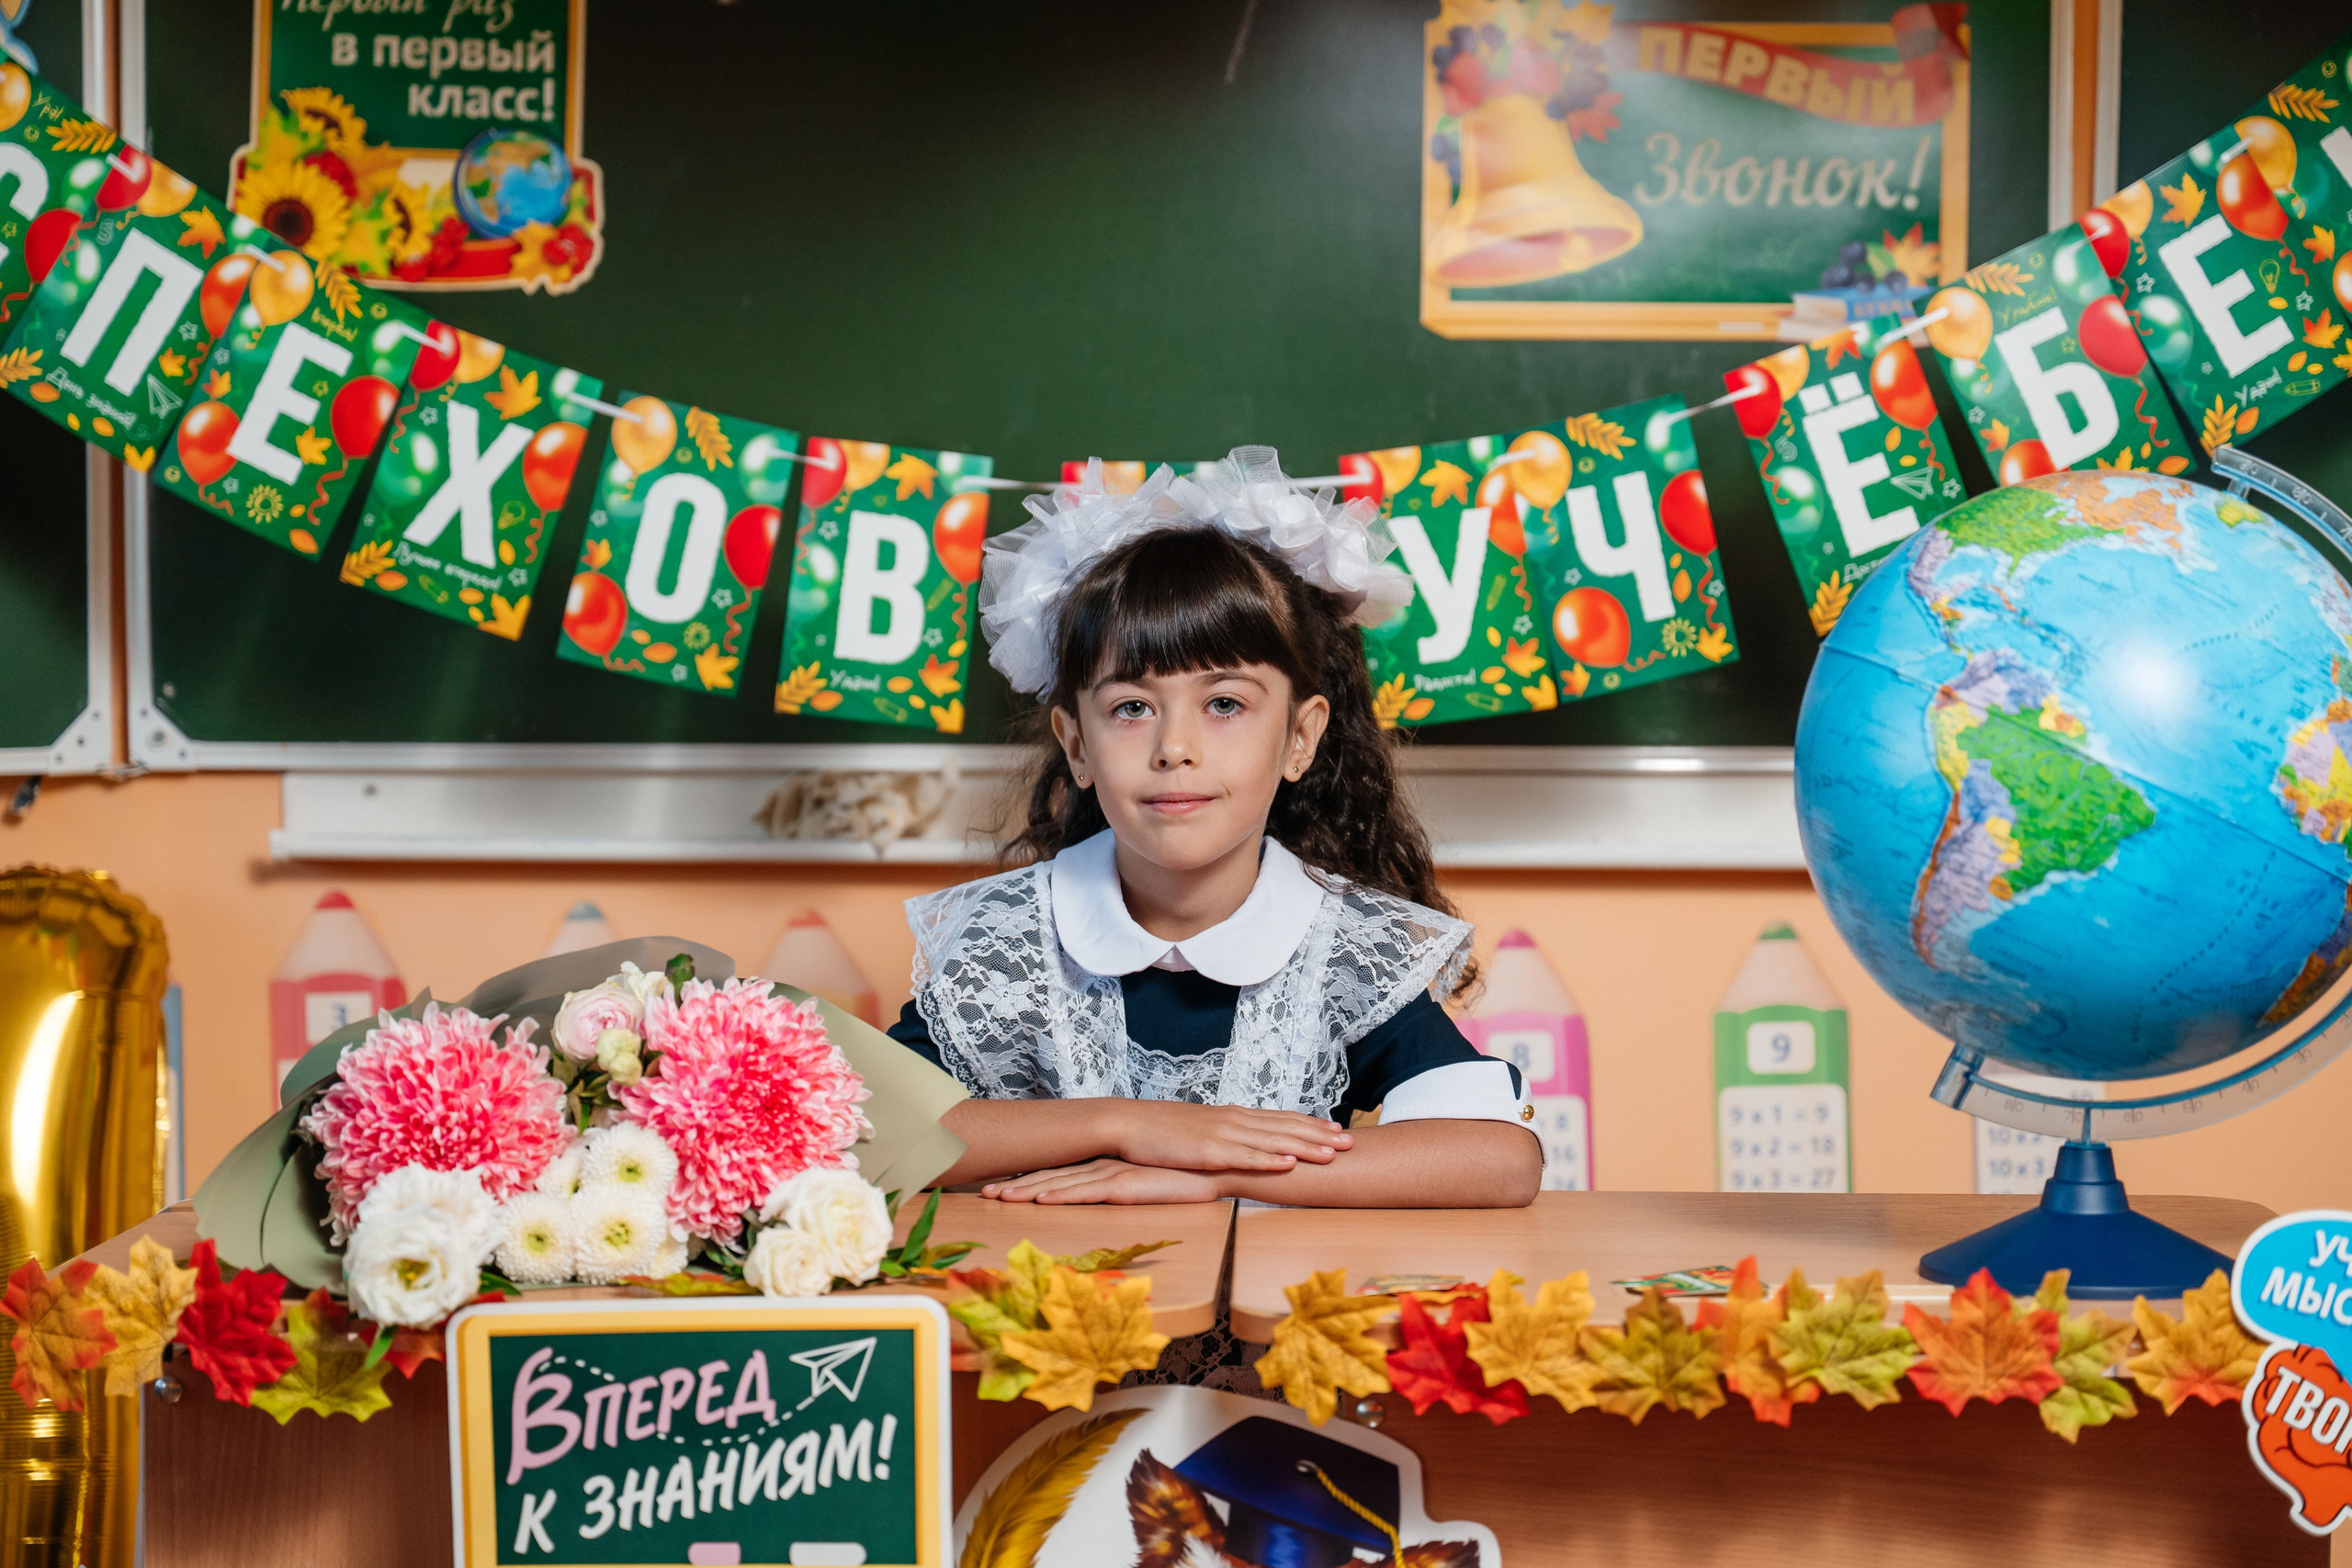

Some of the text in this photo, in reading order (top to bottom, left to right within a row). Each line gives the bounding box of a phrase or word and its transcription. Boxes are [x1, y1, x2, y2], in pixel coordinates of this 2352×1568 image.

[332, 29, 555, 80] в первый
[1639, 26, 1915, 124] ПЕРВЫЙ
[407, 77, 555, 122] класс!
[1634, 131, 1931, 211] Звонок!
[2233, 366, 2283, 409] Удачи!
[1512, 1043, 1530, 1072] 8
[1771, 1032, 1792, 1065] 9
[2260, 1265, 2352, 1326] МЫС
[579, 1413, 899, 1541] ЗНАНИЯМ!
